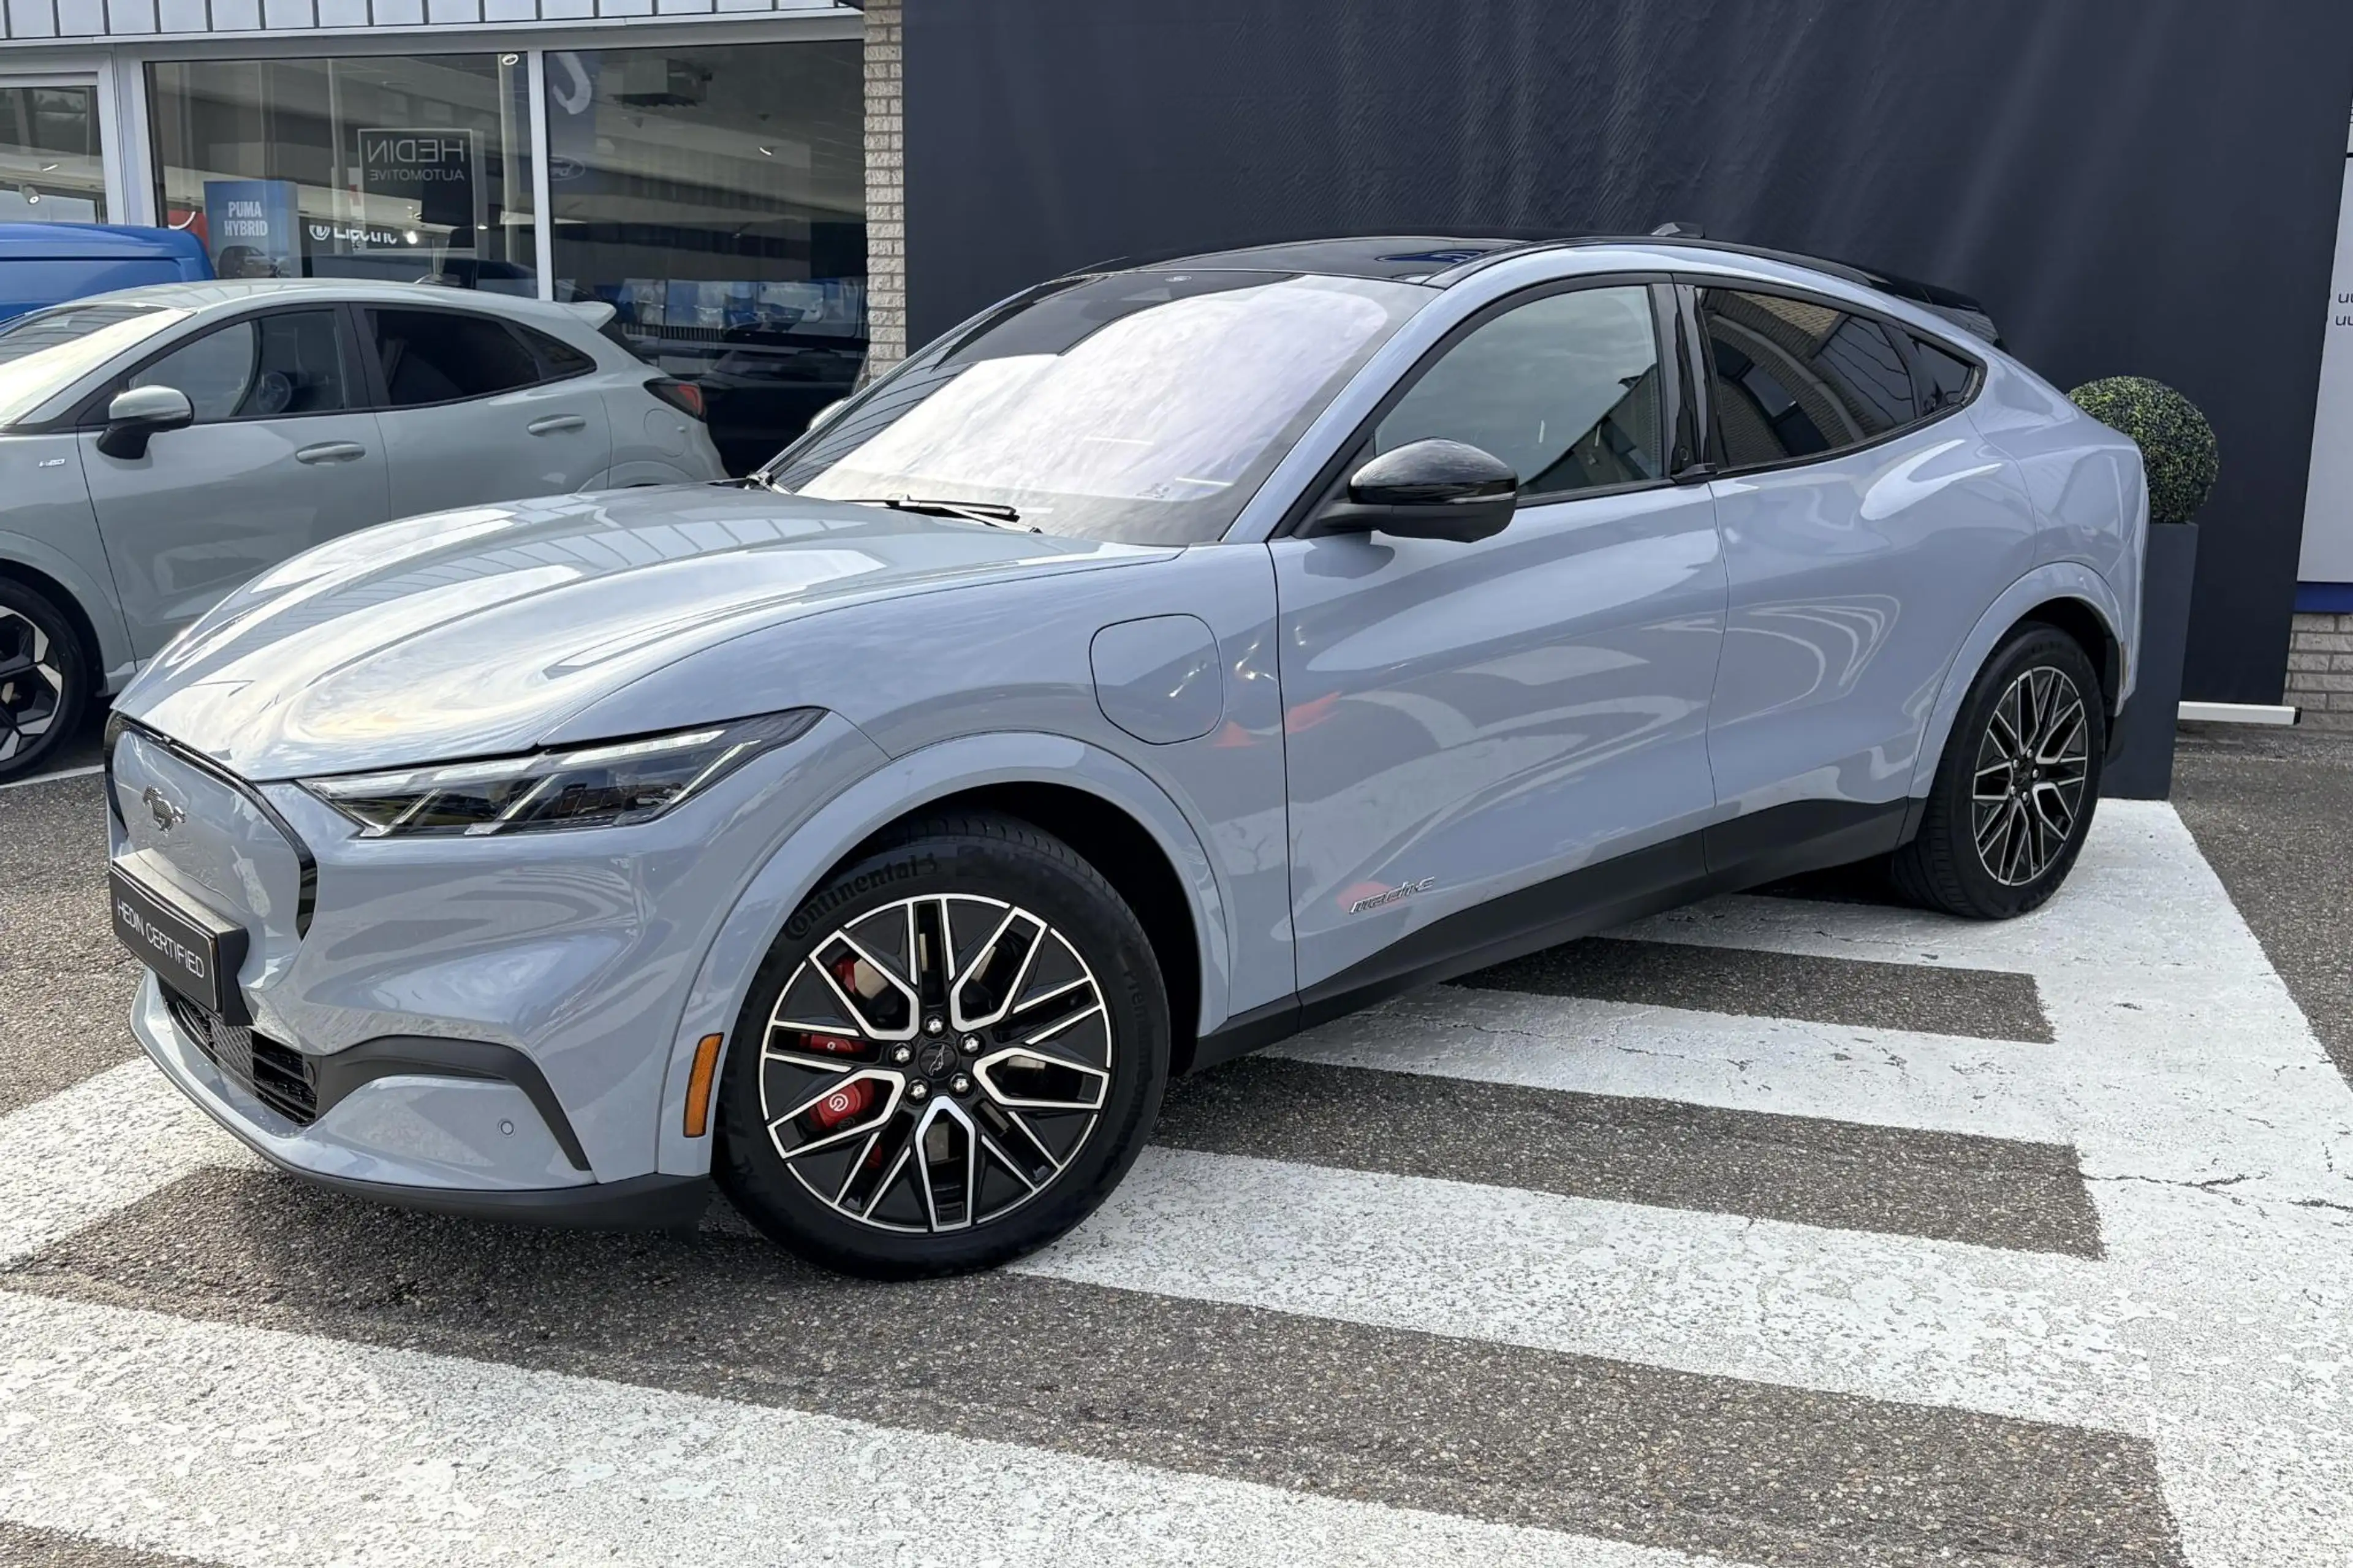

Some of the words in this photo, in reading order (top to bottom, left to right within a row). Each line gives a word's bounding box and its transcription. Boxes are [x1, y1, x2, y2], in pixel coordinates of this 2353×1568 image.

[224, 220, 268, 237] HYBRID
[229, 201, 262, 218] PUMA
[784, 854, 919, 941] Continental
[117, 896, 145, 937] HEDIN
[146, 922, 204, 979] CERTIFIED
